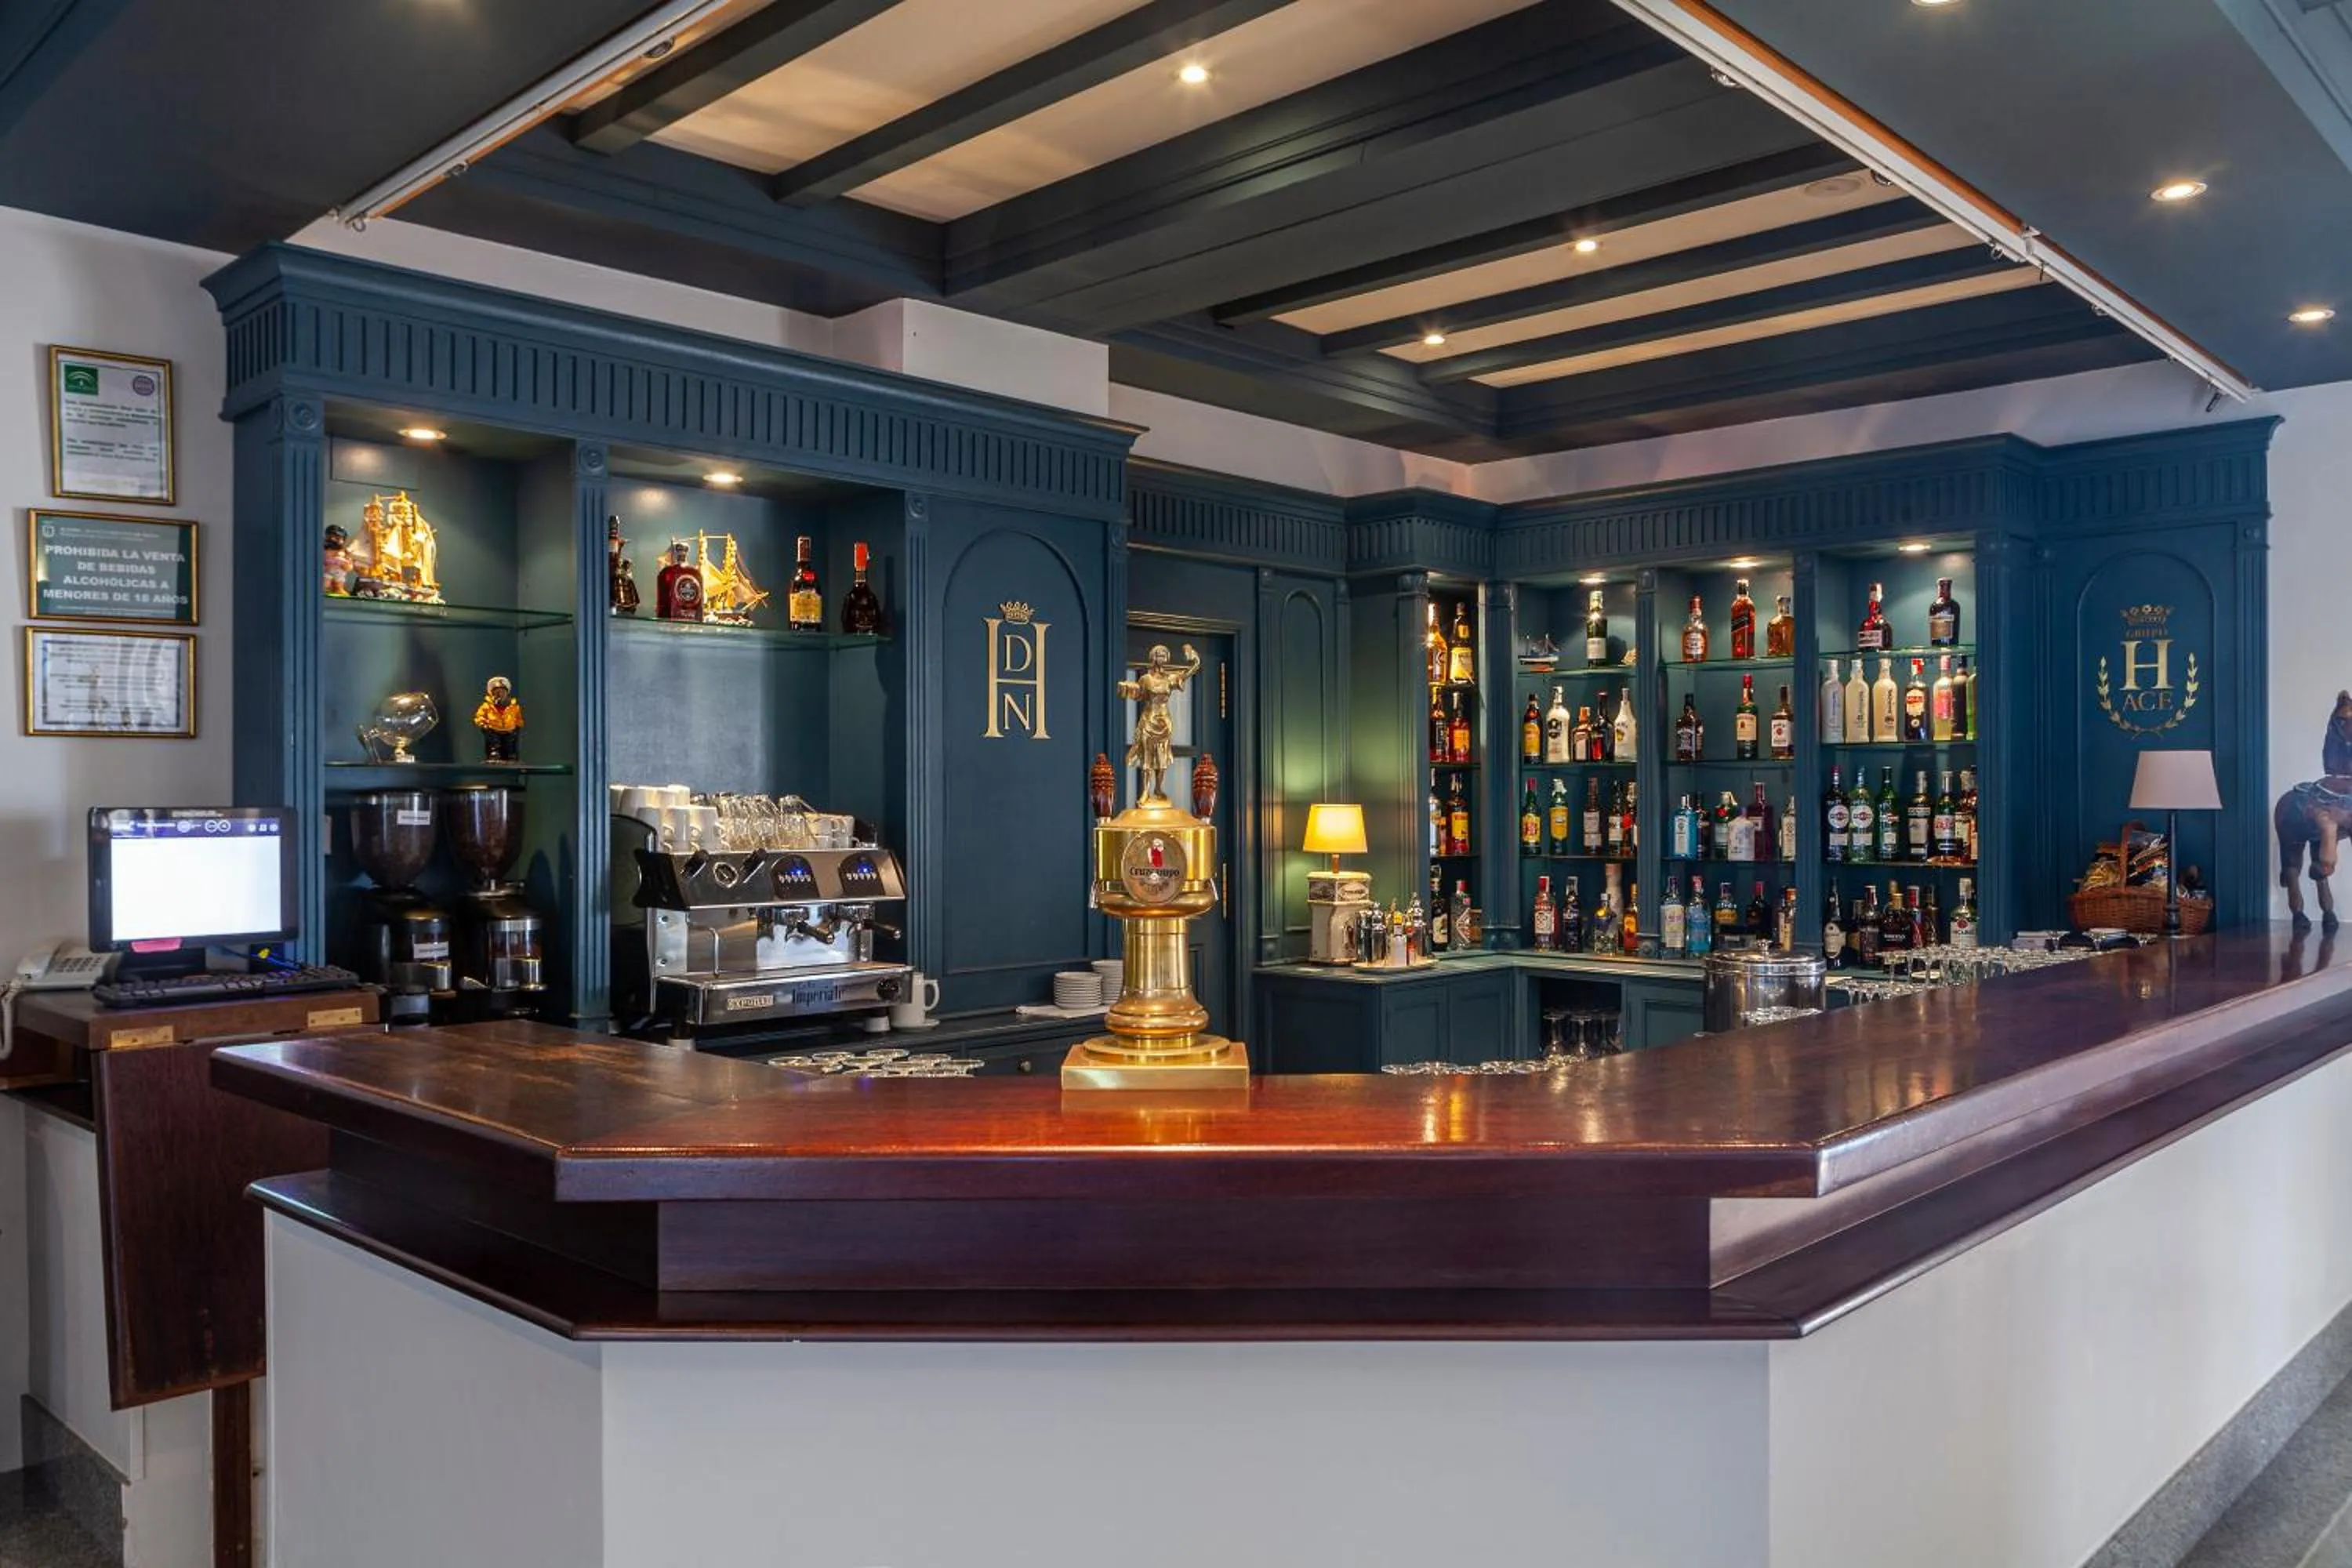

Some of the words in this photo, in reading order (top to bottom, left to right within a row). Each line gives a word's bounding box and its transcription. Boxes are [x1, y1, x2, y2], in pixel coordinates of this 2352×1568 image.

[45, 545, 118, 558] PROHIBIDA
[122, 550, 139, 560] LA
[142, 551, 185, 562] VENTA
[77, 561, 96, 572] DE
[99, 562, 155, 575] BEBIDAS
[161, 579, 169, 589] A
[43, 589, 109, 601] MENORES
[113, 591, 130, 601] DE
[135, 593, 150, 602] 18
